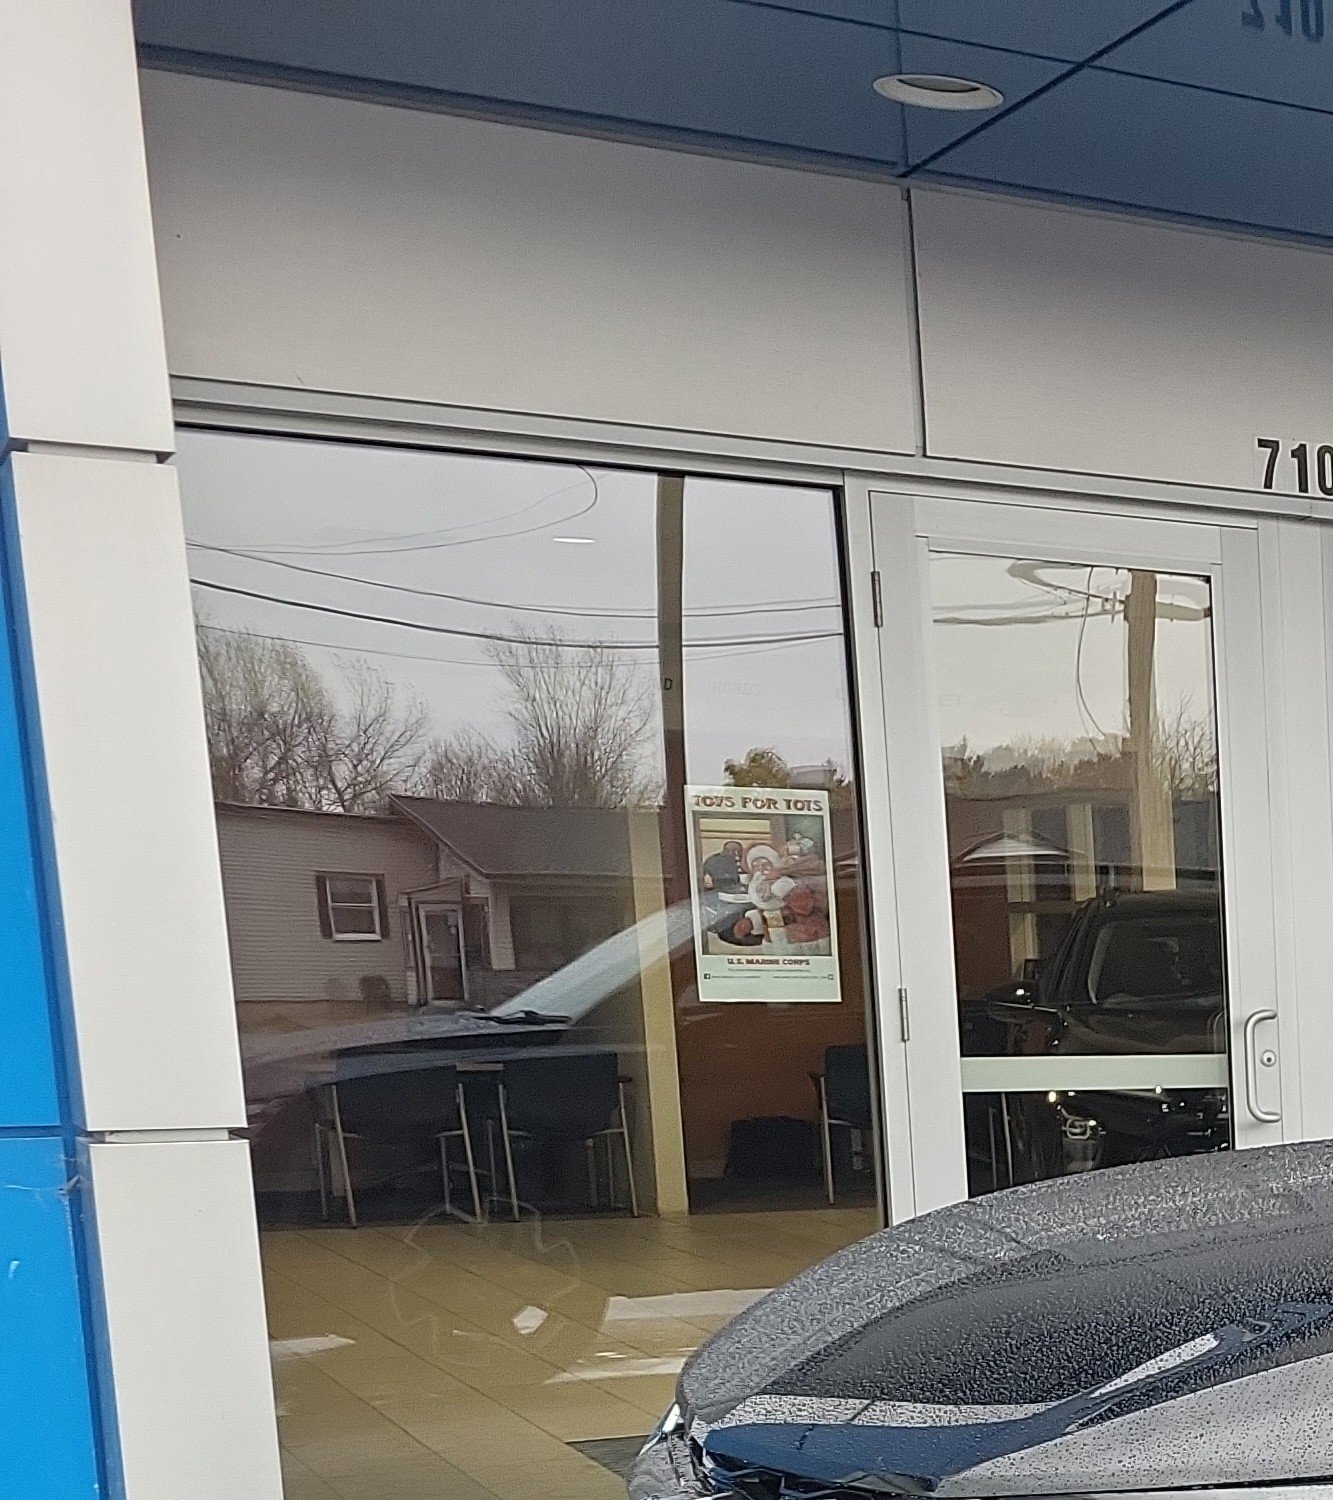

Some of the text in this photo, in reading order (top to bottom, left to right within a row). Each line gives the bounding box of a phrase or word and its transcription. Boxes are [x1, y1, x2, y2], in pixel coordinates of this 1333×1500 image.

[693, 794, 824, 812] TOYS FOR TOTS
[782, 958, 810, 966] CORPS
